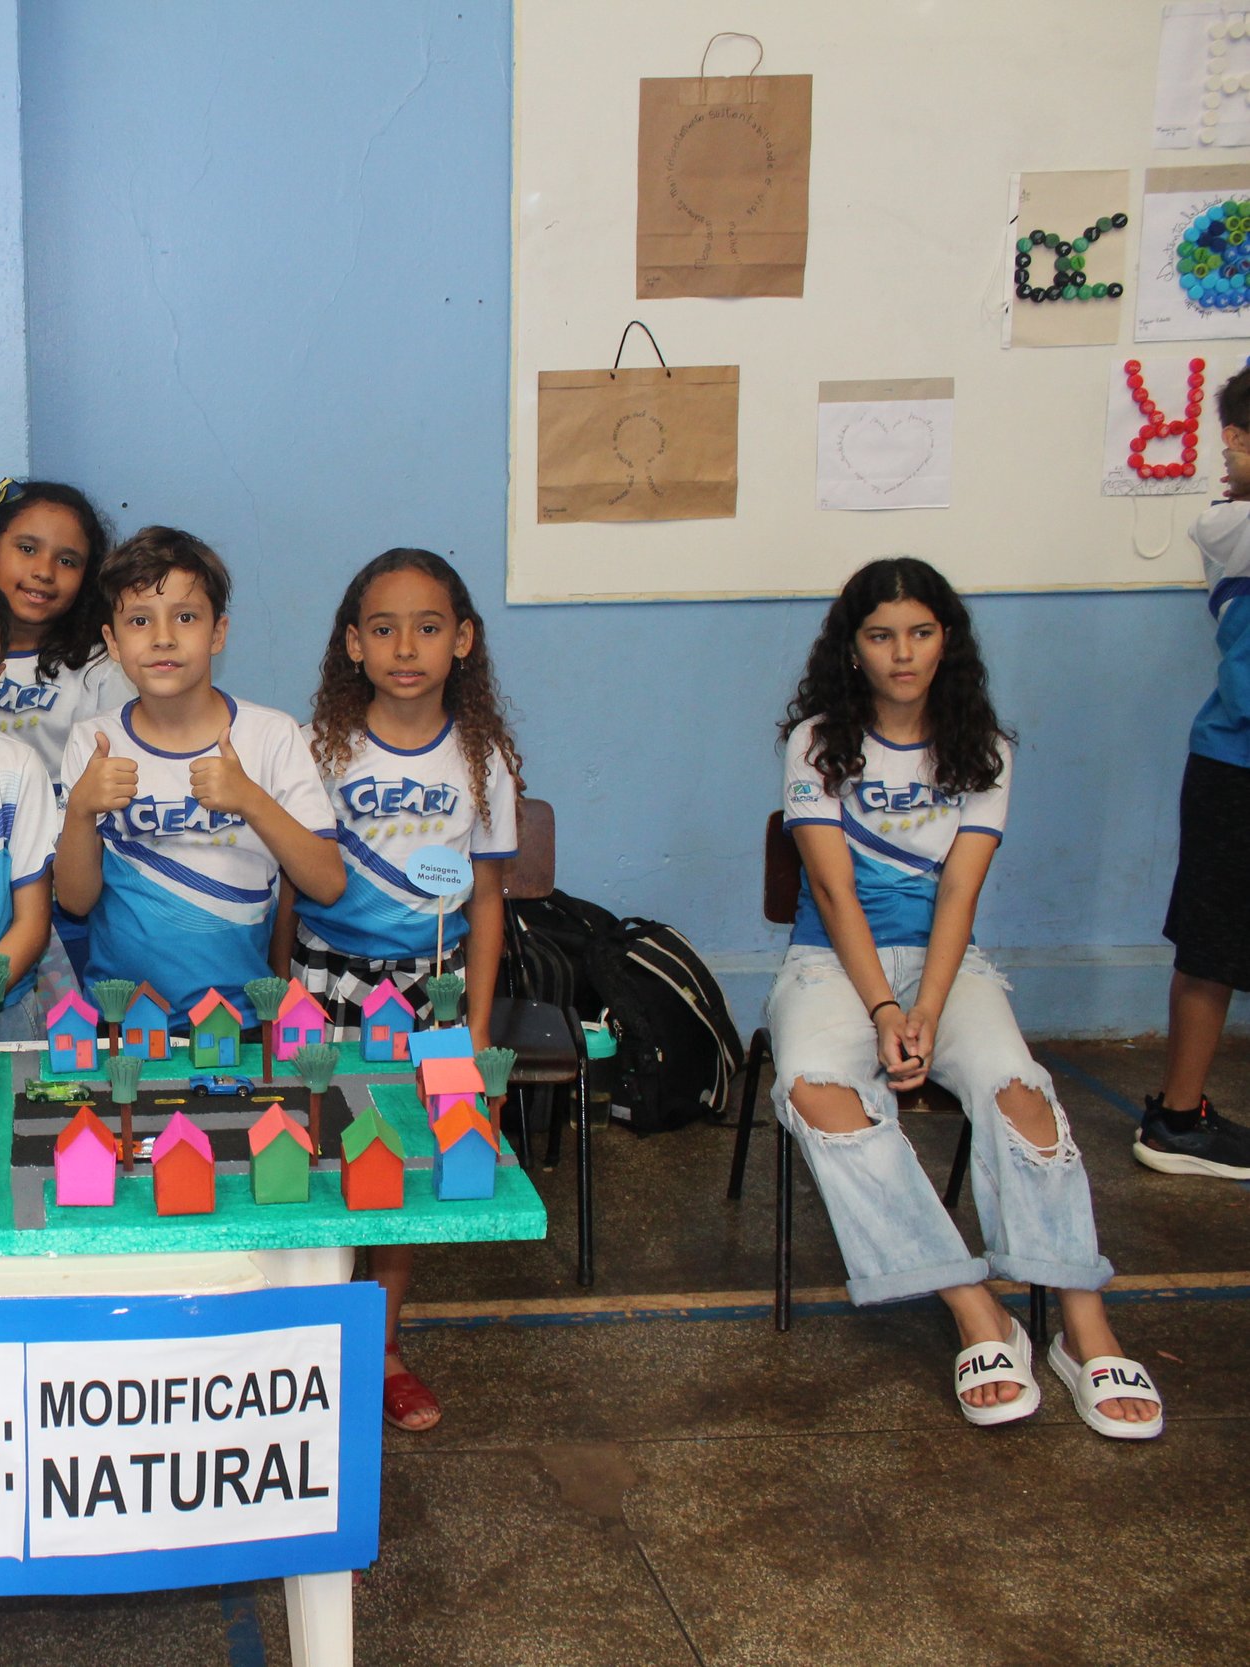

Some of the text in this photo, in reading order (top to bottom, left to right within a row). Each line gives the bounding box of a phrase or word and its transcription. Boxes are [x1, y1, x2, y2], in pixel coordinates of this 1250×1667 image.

[350, 782, 460, 815] CEART
[417, 873, 462, 884] Modificada
[420, 863, 459, 875] Paisagem
[958, 1352, 1014, 1382] FILA
[1091, 1368, 1151, 1389] FILA
[40, 1366, 330, 1428] MODIFICADA
[43, 1440, 329, 1518] NATURAL
